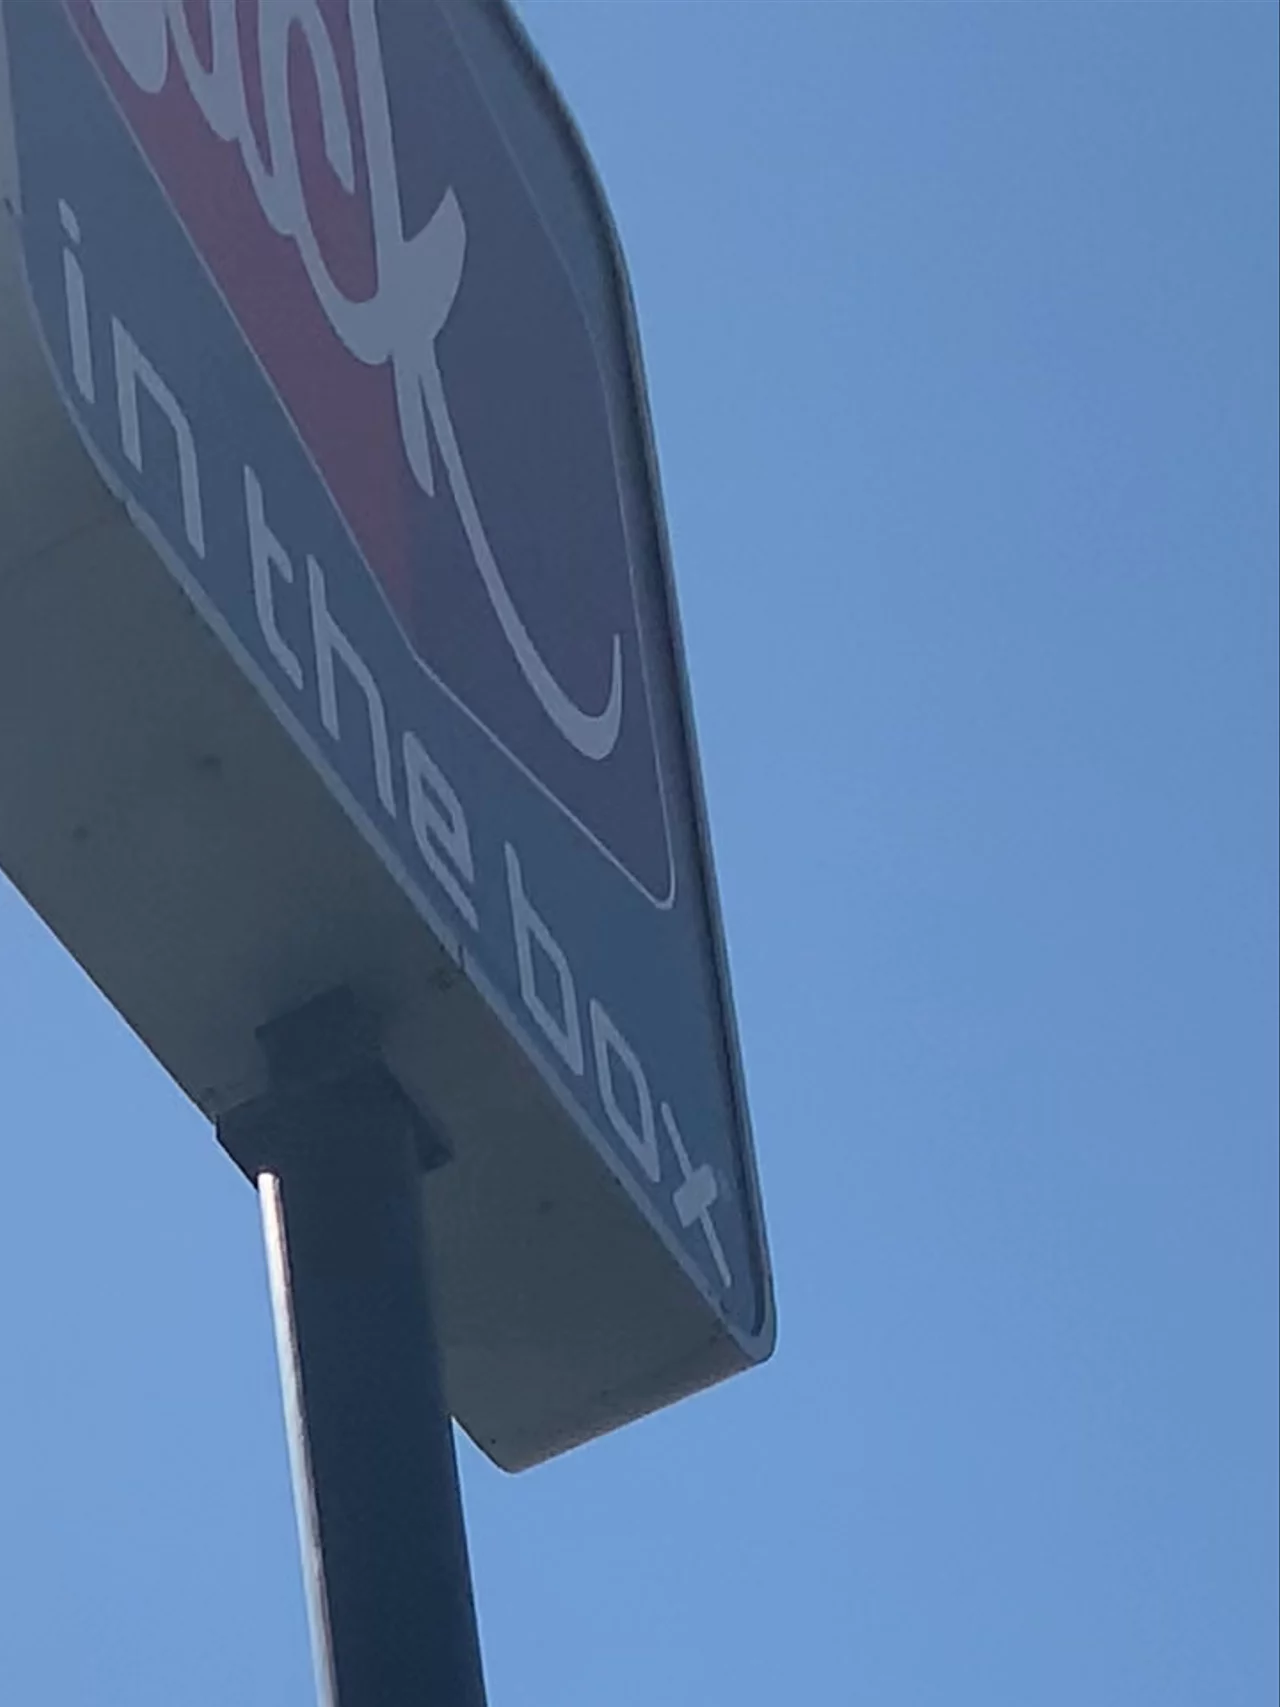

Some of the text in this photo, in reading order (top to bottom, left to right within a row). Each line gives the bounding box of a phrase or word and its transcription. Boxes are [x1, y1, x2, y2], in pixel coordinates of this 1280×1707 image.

[58, 199, 731, 1287] in the box
